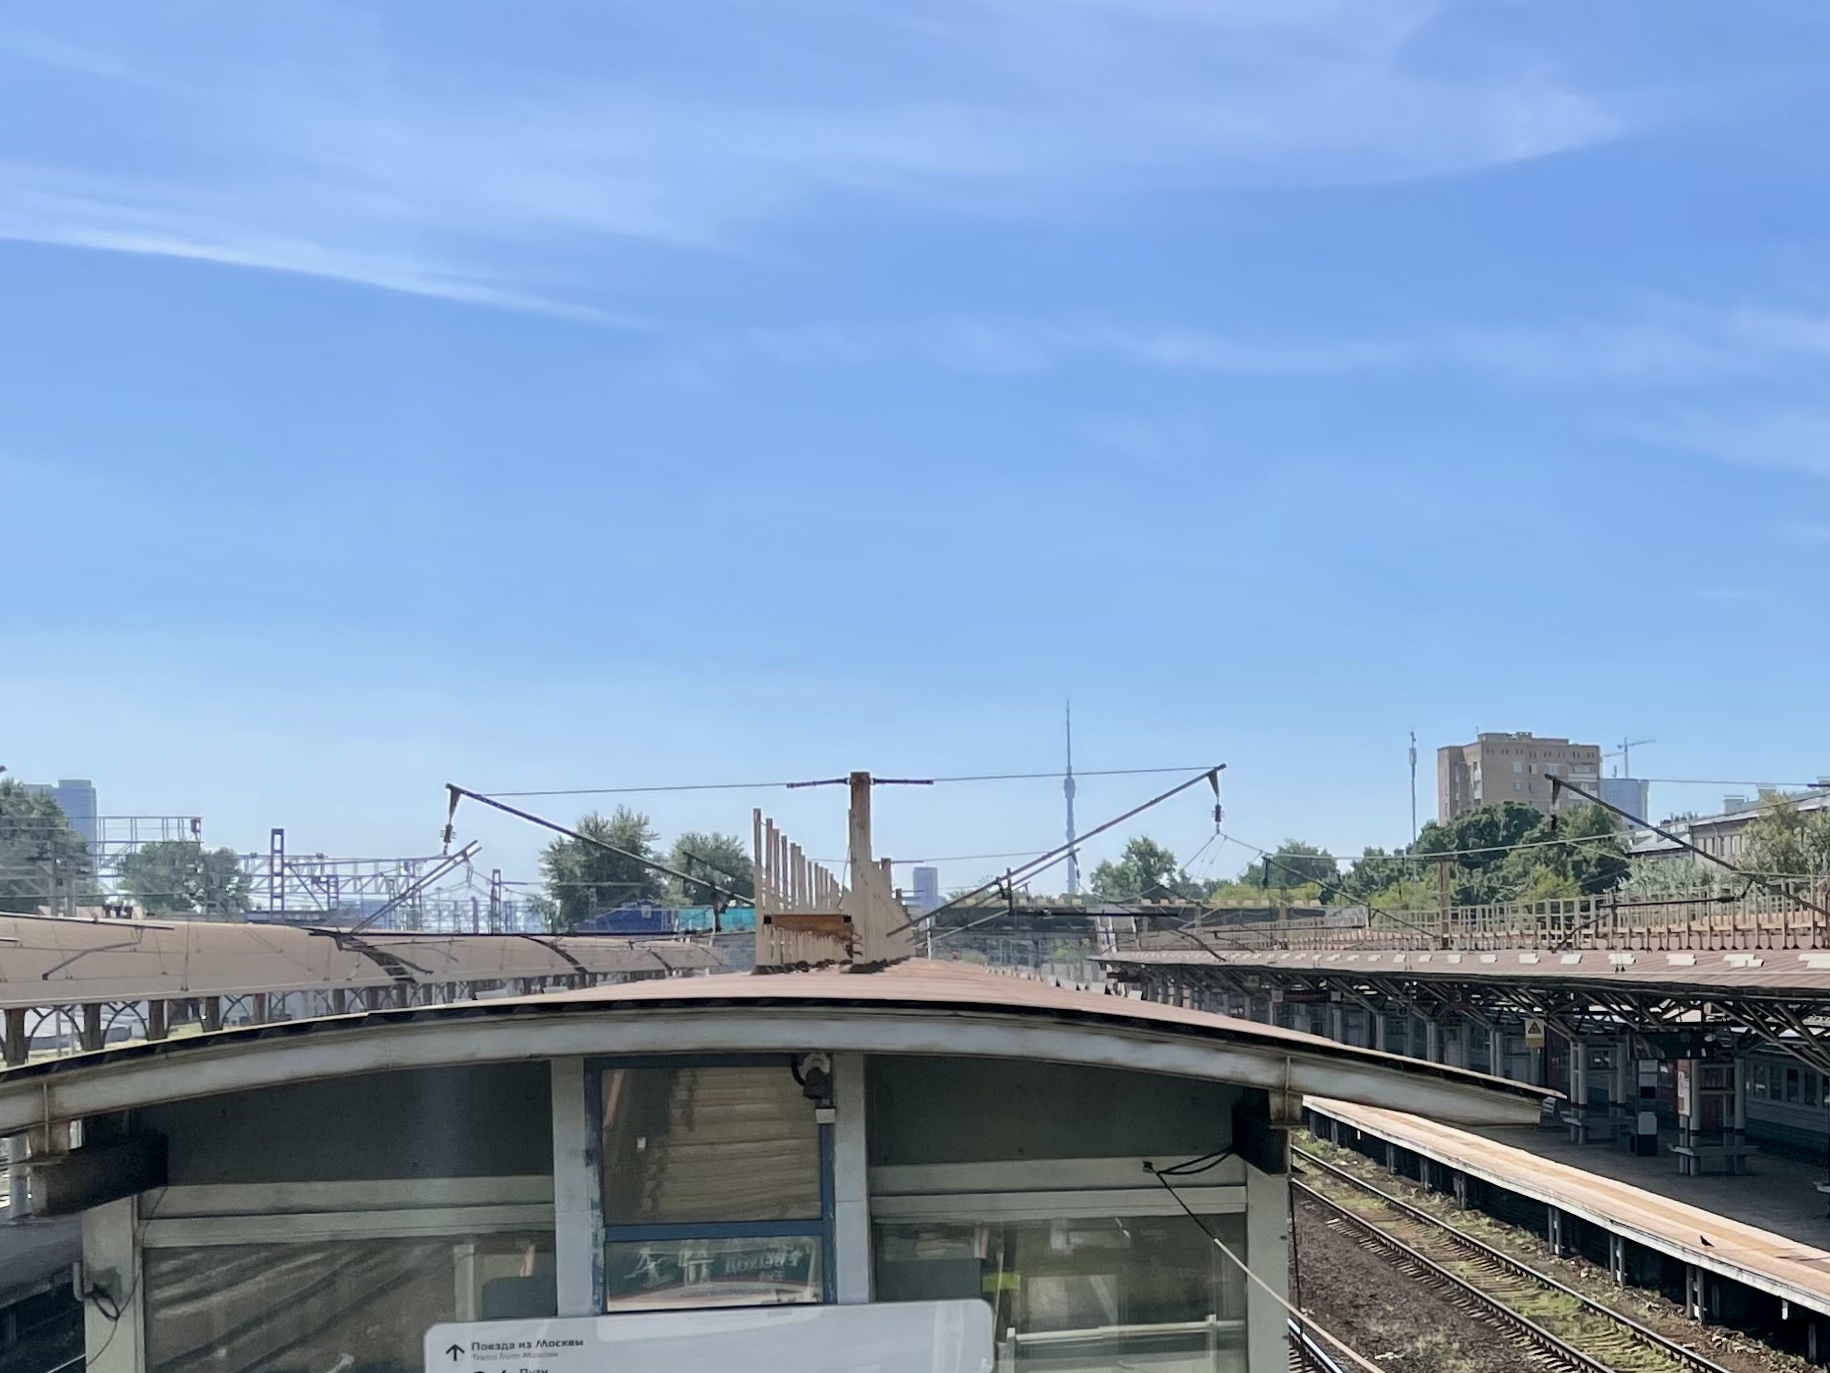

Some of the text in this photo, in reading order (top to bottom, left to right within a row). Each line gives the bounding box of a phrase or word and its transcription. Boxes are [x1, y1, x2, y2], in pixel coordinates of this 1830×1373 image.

[471, 1339, 584, 1351] Поезда из Москвы
